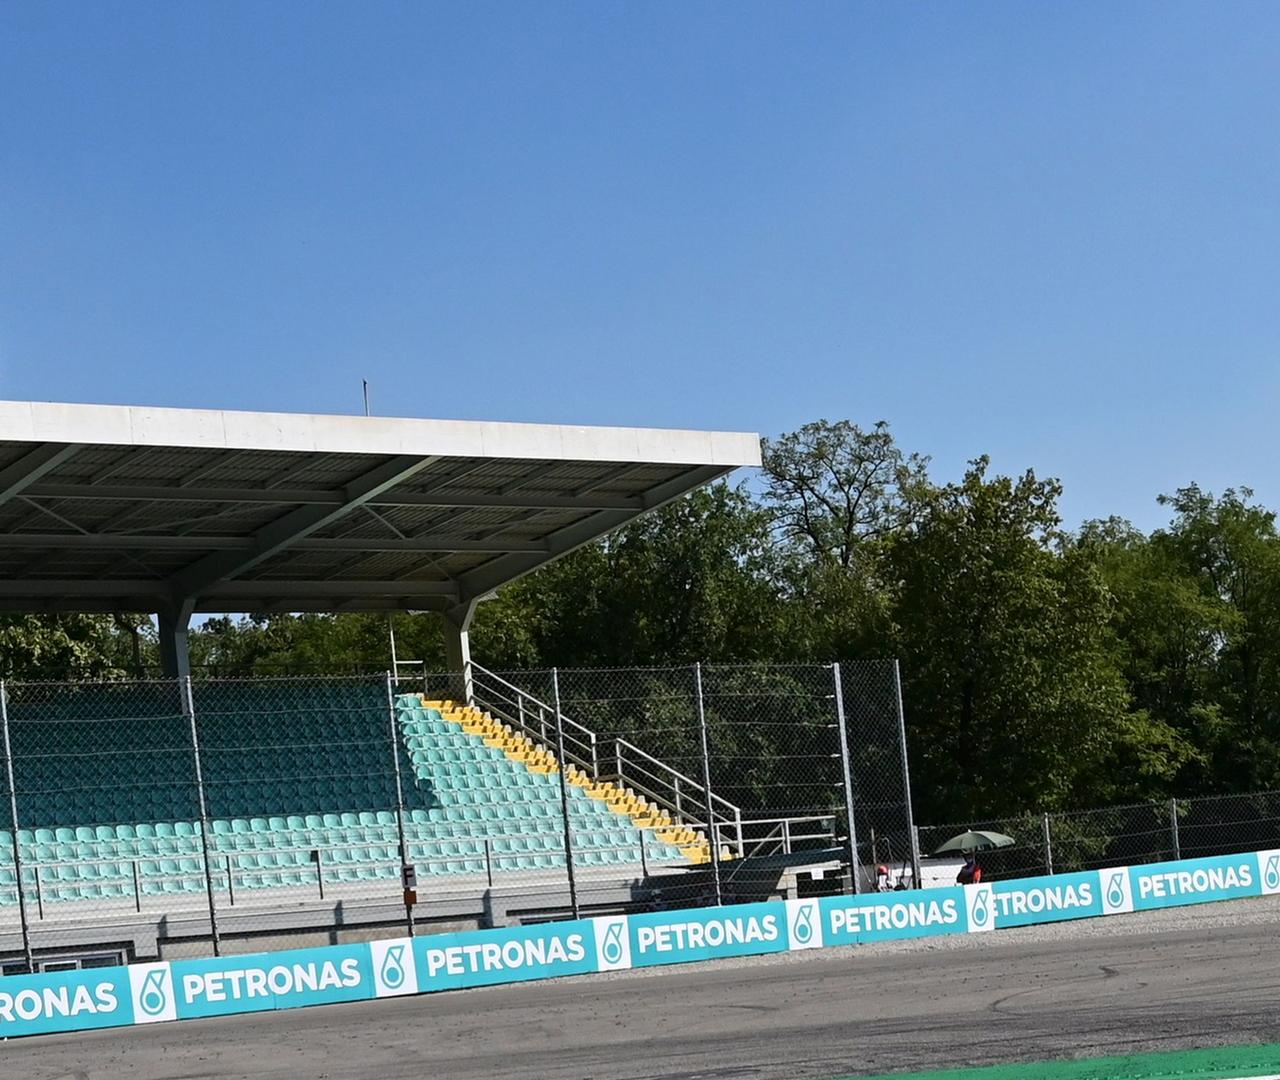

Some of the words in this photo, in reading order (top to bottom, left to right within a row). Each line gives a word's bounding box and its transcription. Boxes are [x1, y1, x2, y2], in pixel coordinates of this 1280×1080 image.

[1138, 865, 1252, 898] PETRONAS
[830, 900, 958, 934] PETRONAS
[991, 883, 1093, 917] ETRONAS
[638, 914, 778, 953] PETRONAS
[426, 934, 585, 977] PETRONAS
[184, 958, 361, 1003] PETRONAS
